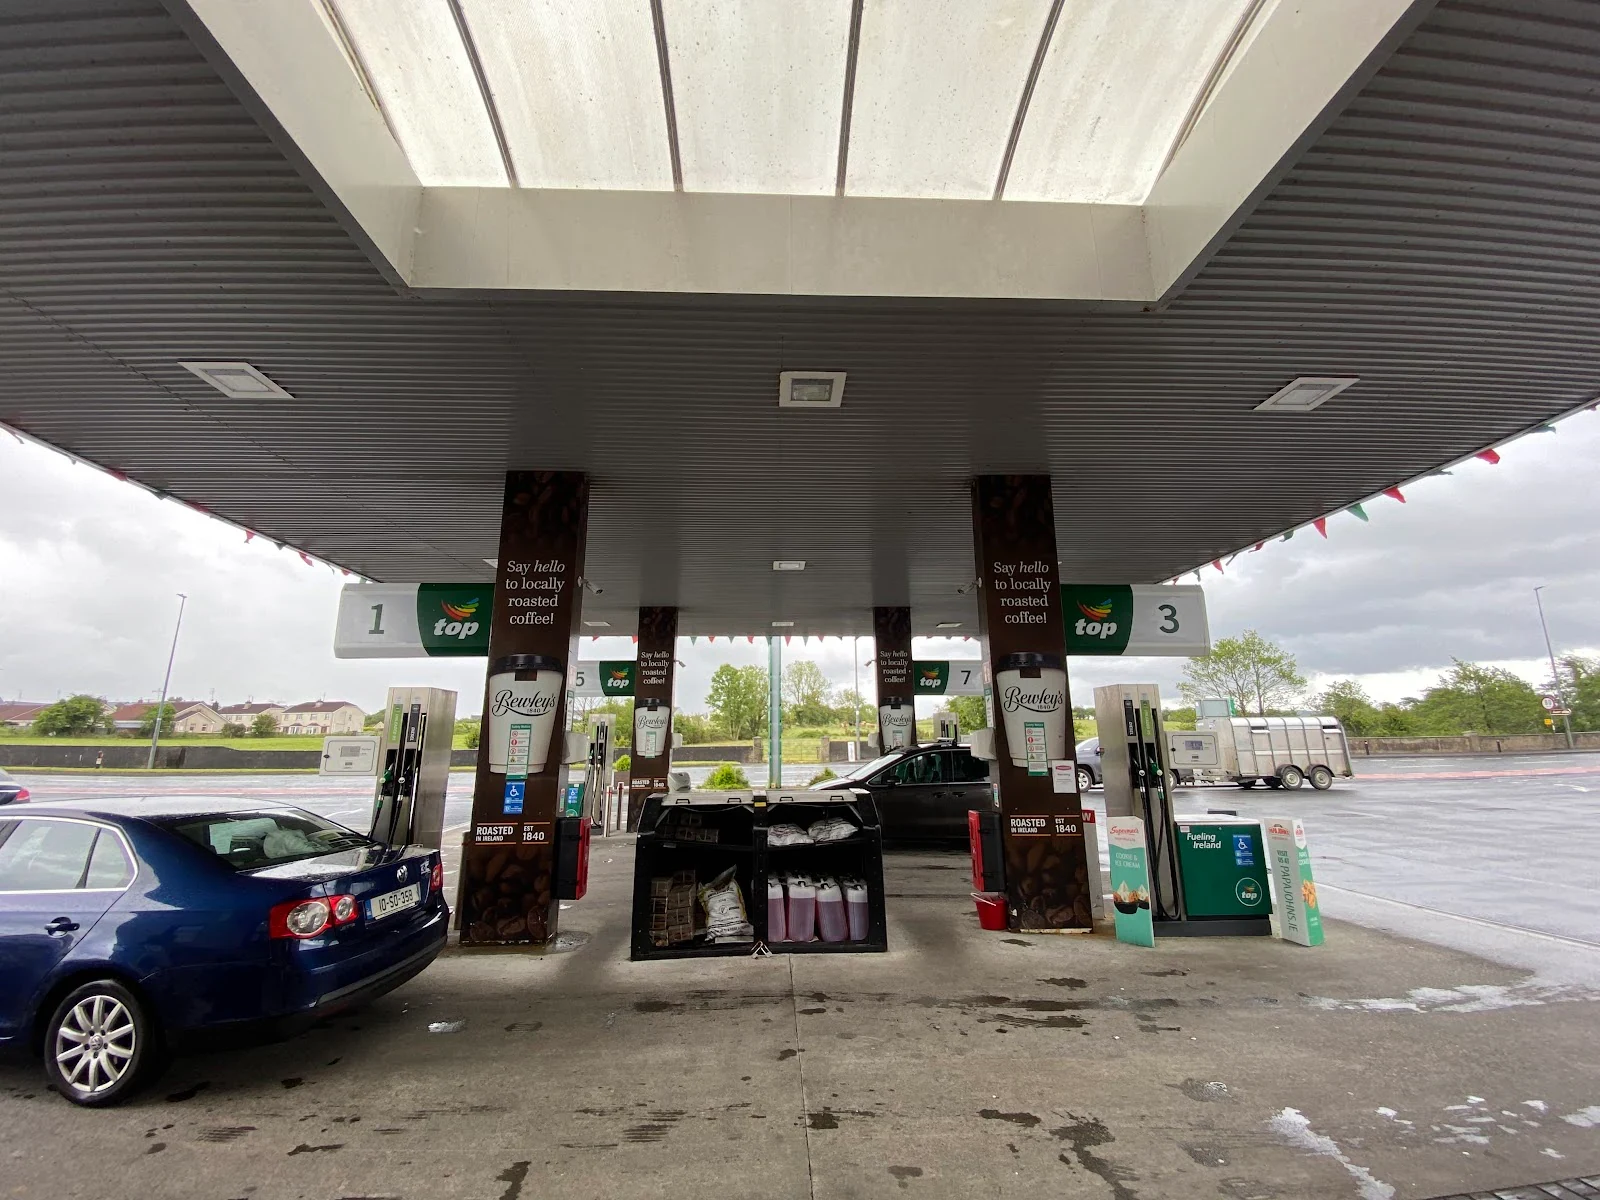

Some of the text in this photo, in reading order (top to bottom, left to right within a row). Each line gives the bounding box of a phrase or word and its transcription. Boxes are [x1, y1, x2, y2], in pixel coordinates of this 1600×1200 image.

[507, 560, 566, 576] Say hello
[994, 560, 1049, 577] Say hello
[506, 577, 565, 593] to locally
[994, 577, 1051, 593] to locally
[508, 594, 558, 607] roasted
[1000, 594, 1049, 607] roasted
[368, 603, 385, 635] 1
[510, 611, 554, 625] coffee!
[1004, 611, 1047, 624] coffee!
[1158, 604, 1180, 634] 3
[433, 617, 480, 640] top
[1074, 618, 1118, 640] top
[641, 650, 670, 660] Say hello
[880, 650, 908, 659] Say hello
[648, 659, 670, 668] locally
[888, 658, 909, 667] locally
[642, 668, 667, 676] roasted
[883, 667, 906, 675] roasted
[960, 670, 972, 685] 7
[575, 671, 585, 687] 5
[607, 677, 630, 689] top
[643, 677, 665, 685] coffee!
[919, 676, 942, 688] top
[491, 689, 557, 717] Bewley's
[1003, 685, 1064, 713] Bewley's
[1010, 818, 1046, 827] ROASTED
[1055, 824, 1077, 833] 1840
[476, 826, 514, 836] ROASTED
[522, 831, 545, 841] 1840
[1186, 832, 1217, 843] Fueling
[1193, 840, 1222, 849] Ireland
[1241, 891, 1258, 901] top
[1280, 864, 1299, 933] PAPAJOHNS.IE
